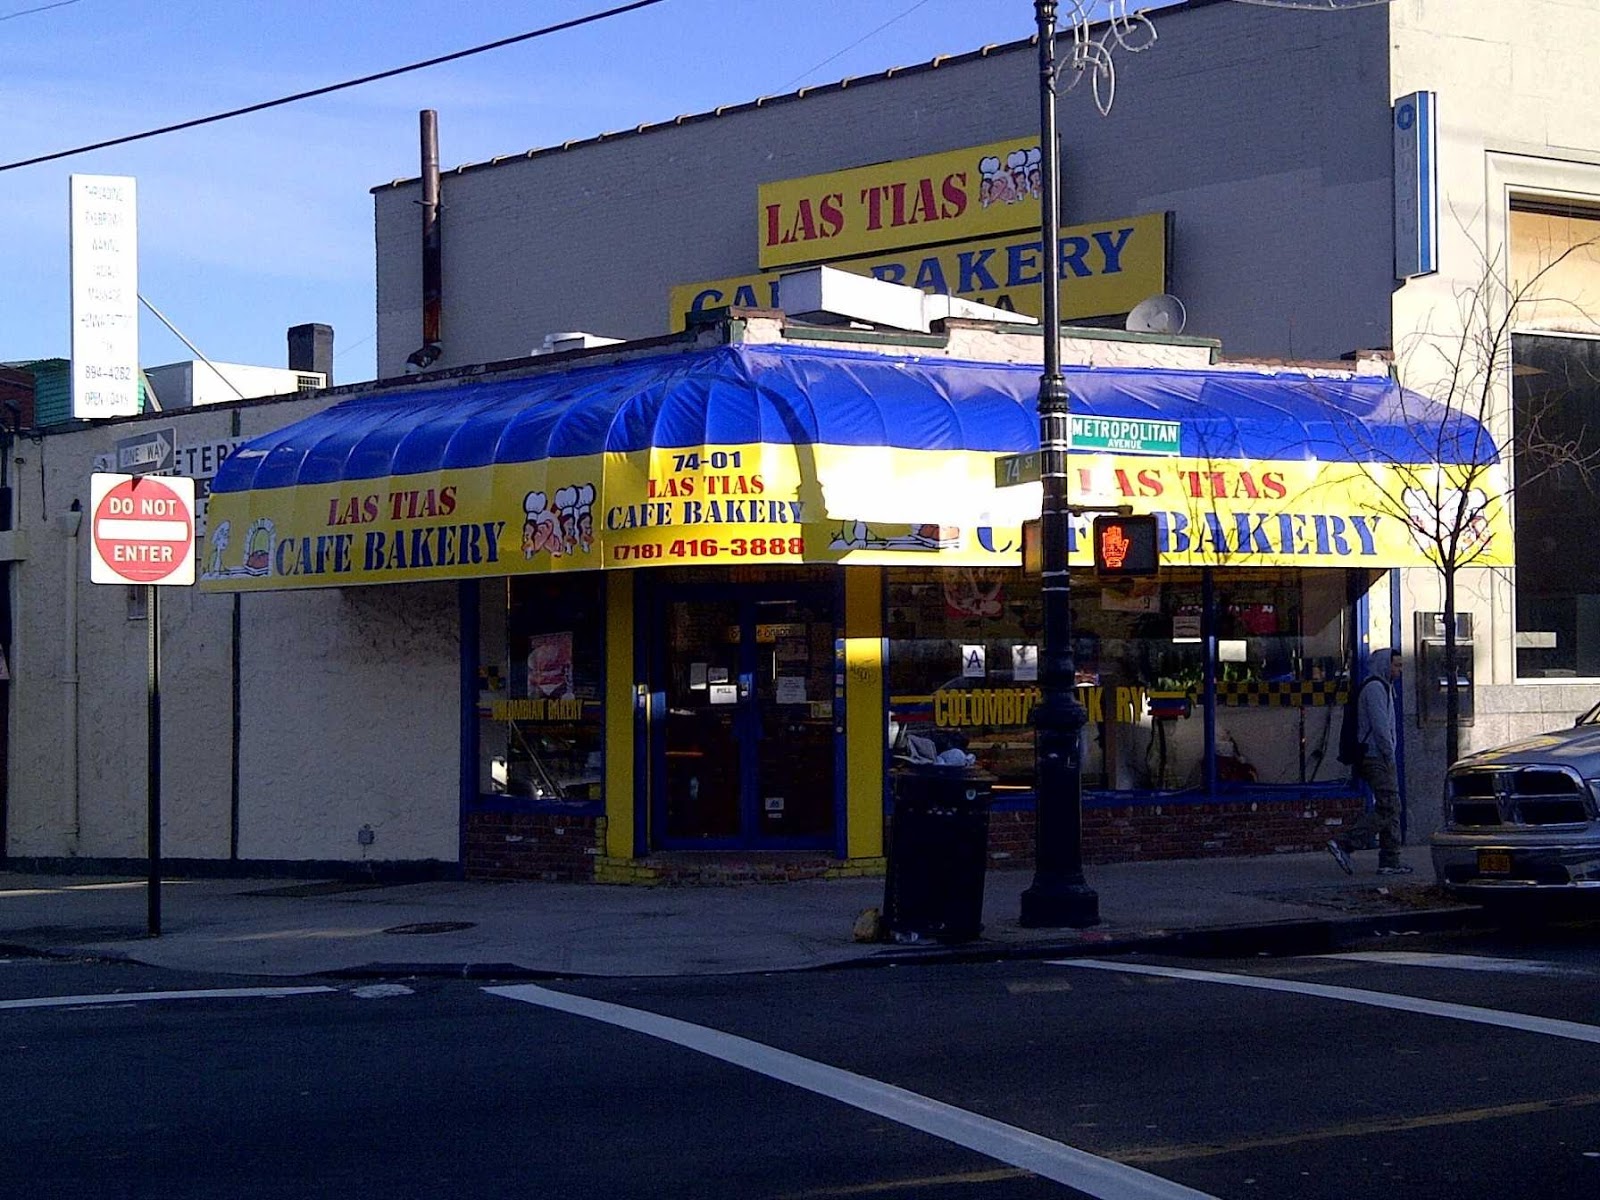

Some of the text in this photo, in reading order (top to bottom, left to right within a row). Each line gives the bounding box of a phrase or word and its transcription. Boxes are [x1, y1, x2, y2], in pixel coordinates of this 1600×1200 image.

[765, 172, 969, 247] LAS TIAS
[1071, 418, 1178, 442] METROPOLITAN
[122, 443, 165, 466] ONE WAY
[1107, 439, 1143, 450] AVENUE
[672, 451, 741, 472] 74-01
[1005, 457, 1034, 481] 74 ST
[648, 475, 765, 498] LAS TIAS
[1180, 470, 1286, 499] TIAS
[109, 497, 134, 515] DO
[141, 499, 177, 516] NOT
[327, 486, 457, 526] LAS TIAS
[607, 500, 805, 530] CAFE BAKERY
[1153, 511, 1381, 556] BAKERY
[113, 545, 173, 562] ENTER
[275, 521, 506, 577] CAFE BAKERY
[669, 538, 805, 558] 416-3888
[967, 650, 982, 668] A
